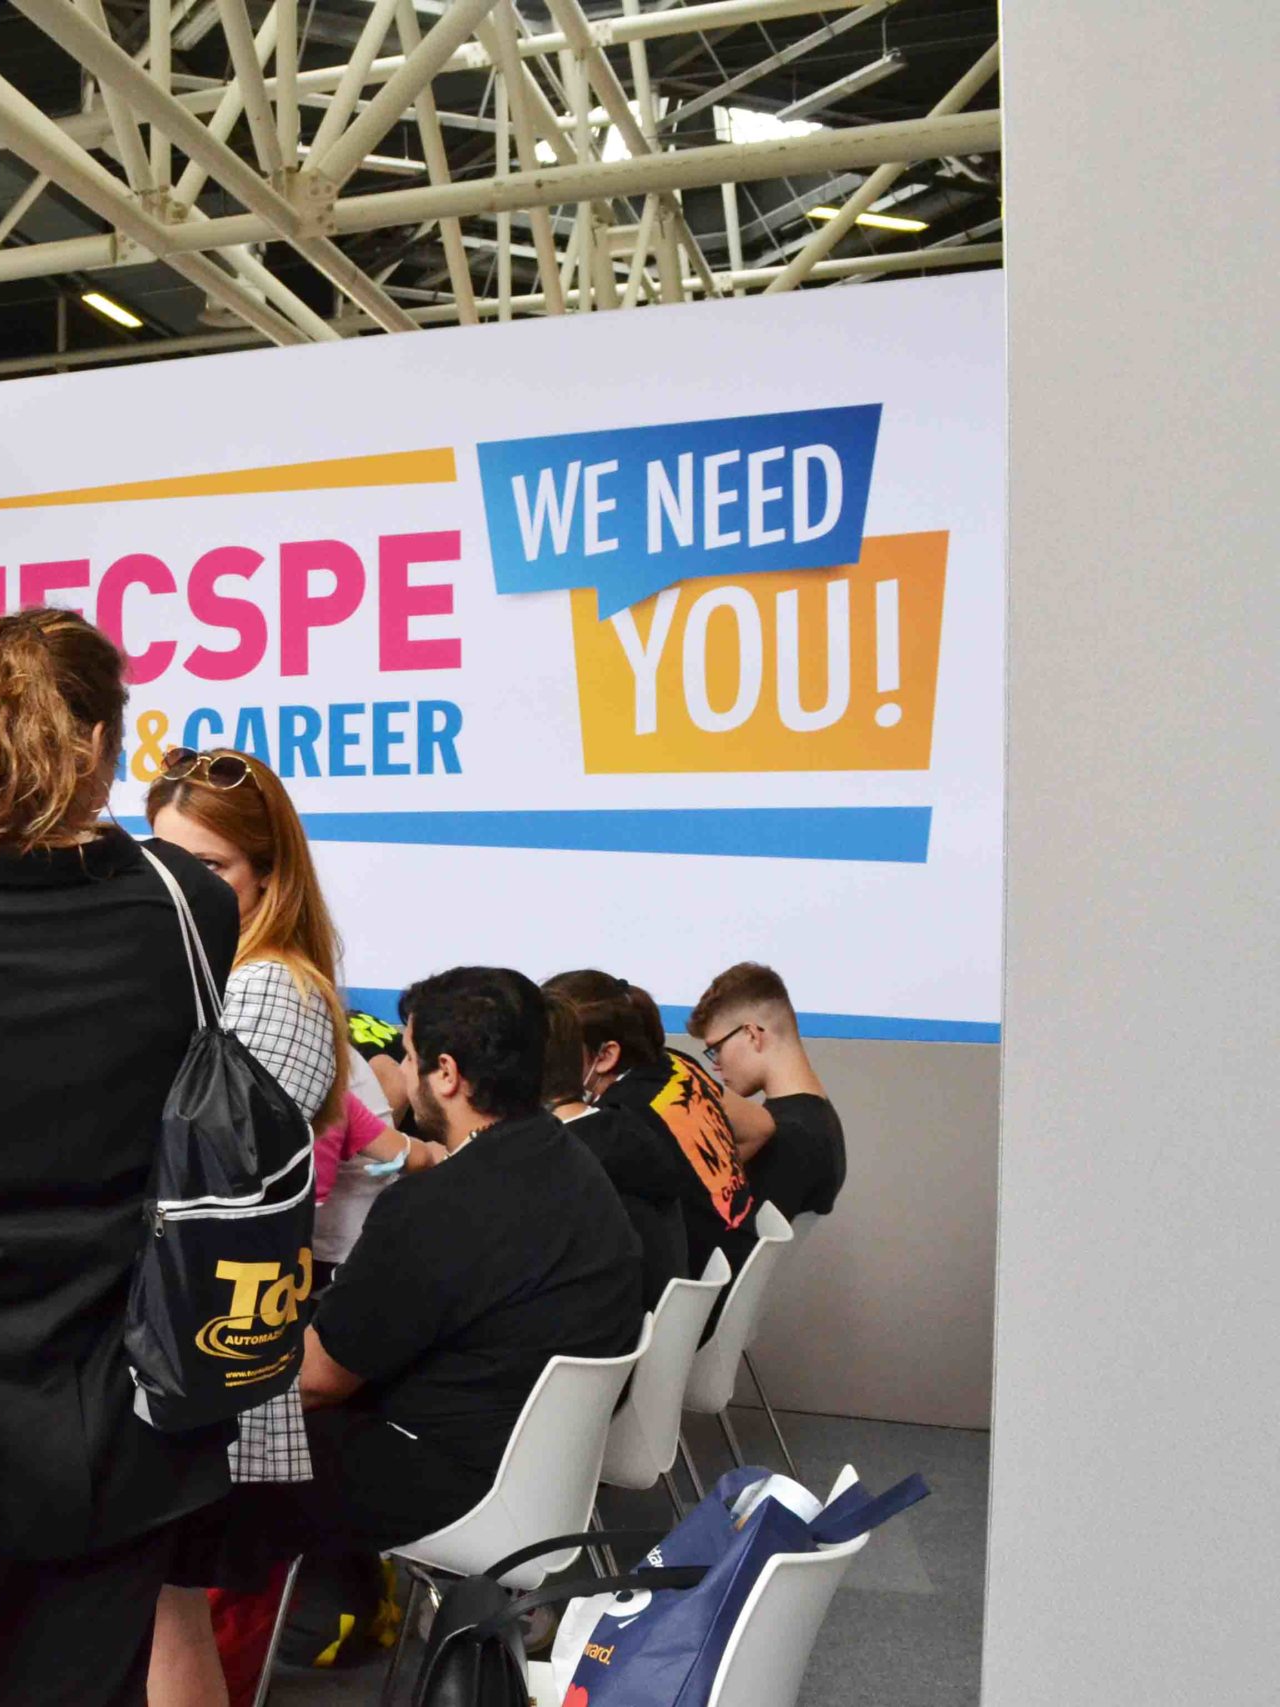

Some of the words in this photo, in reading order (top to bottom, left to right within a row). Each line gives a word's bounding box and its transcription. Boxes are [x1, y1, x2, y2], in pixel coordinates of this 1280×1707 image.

[511, 459, 619, 563] WE
[646, 443, 844, 554] NEED
[609, 578, 904, 737] YOU!
